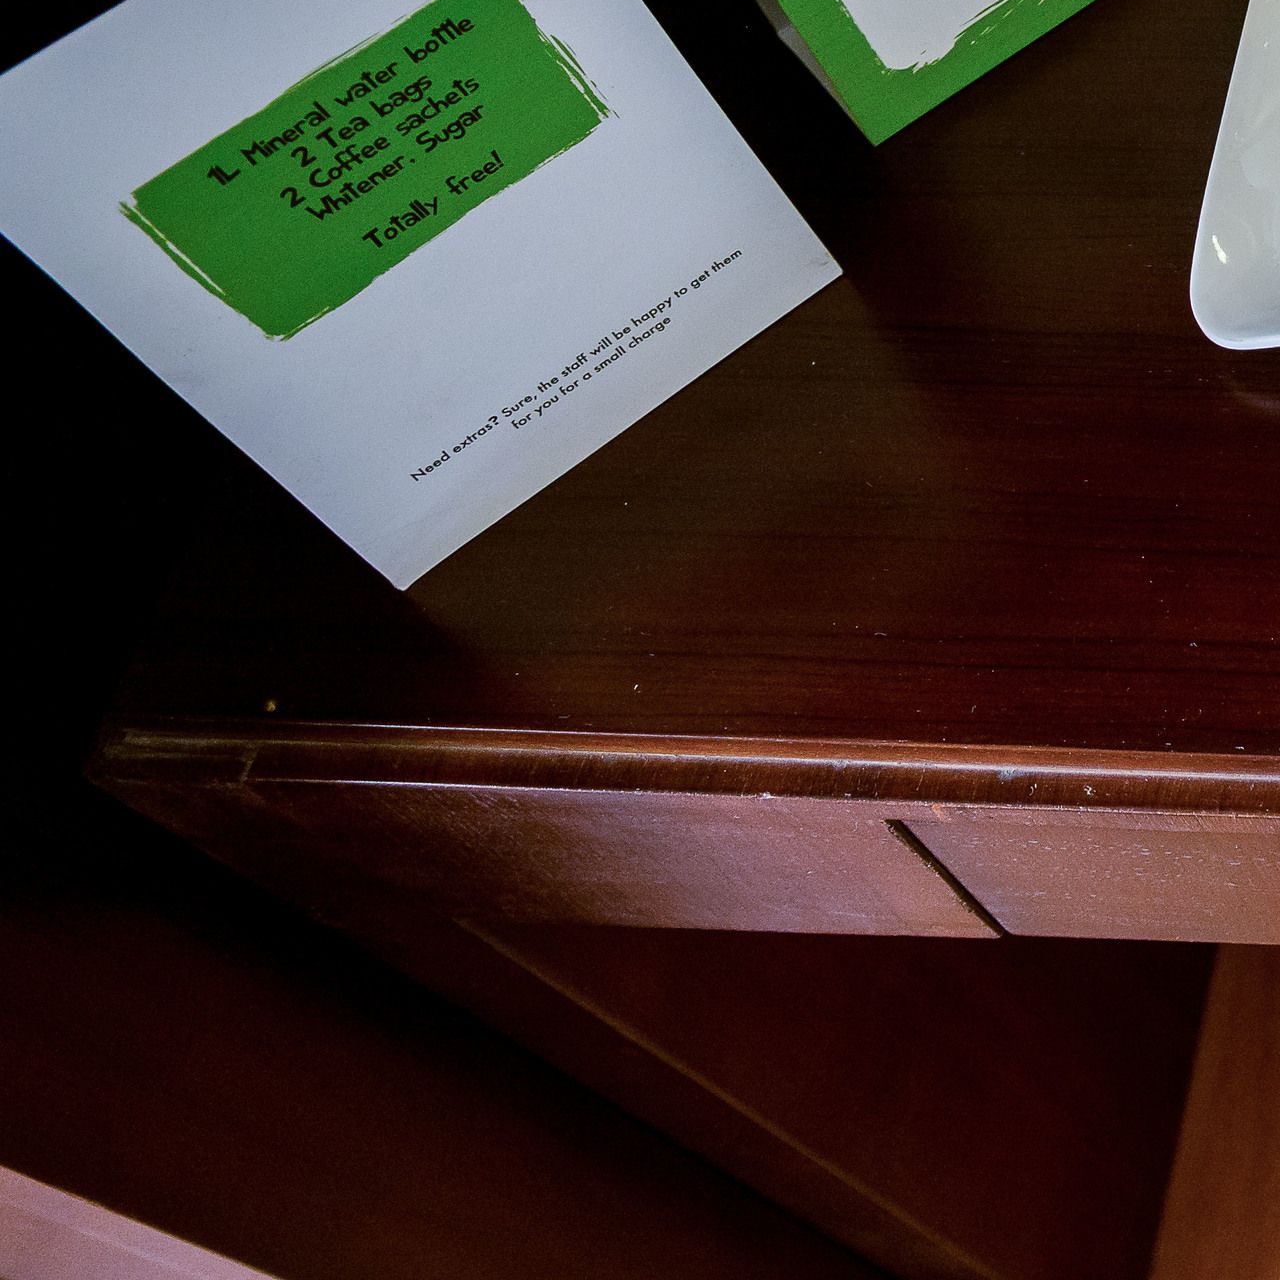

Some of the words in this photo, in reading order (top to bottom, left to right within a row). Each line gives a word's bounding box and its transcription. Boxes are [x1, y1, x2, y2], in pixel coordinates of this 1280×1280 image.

[240, 101, 331, 167] Mineral
[334, 62, 398, 107] water
[403, 17, 475, 63] bottle
[280, 187, 307, 208] 2
[309, 137, 391, 188] Coffee
[395, 78, 479, 137] sachets
[291, 146, 317, 168] 2
[315, 116, 371, 148] Tea
[369, 75, 432, 118] bags
[416, 105, 484, 153] Sugar
[361, 196, 438, 248] Totally
[445, 150, 504, 195] free!
[410, 450, 451, 481] Need
[453, 416, 499, 453] extras?
[501, 395, 537, 417] Sure,
[537, 377, 559, 393] the
[561, 353, 588, 377] staff
[589, 336, 613, 355] will
[611, 327, 631, 340] be
[630, 297, 671, 327] happy
[674, 288, 688, 298] to
[690, 270, 710, 289] get
[711, 250, 742, 272] them
[511, 413, 531, 429] for
[534, 395, 559, 417] you
[559, 380, 578, 395] for
[582, 372, 592, 380] a
[594, 345, 626, 373] small
[628, 317, 671, 348] charge
